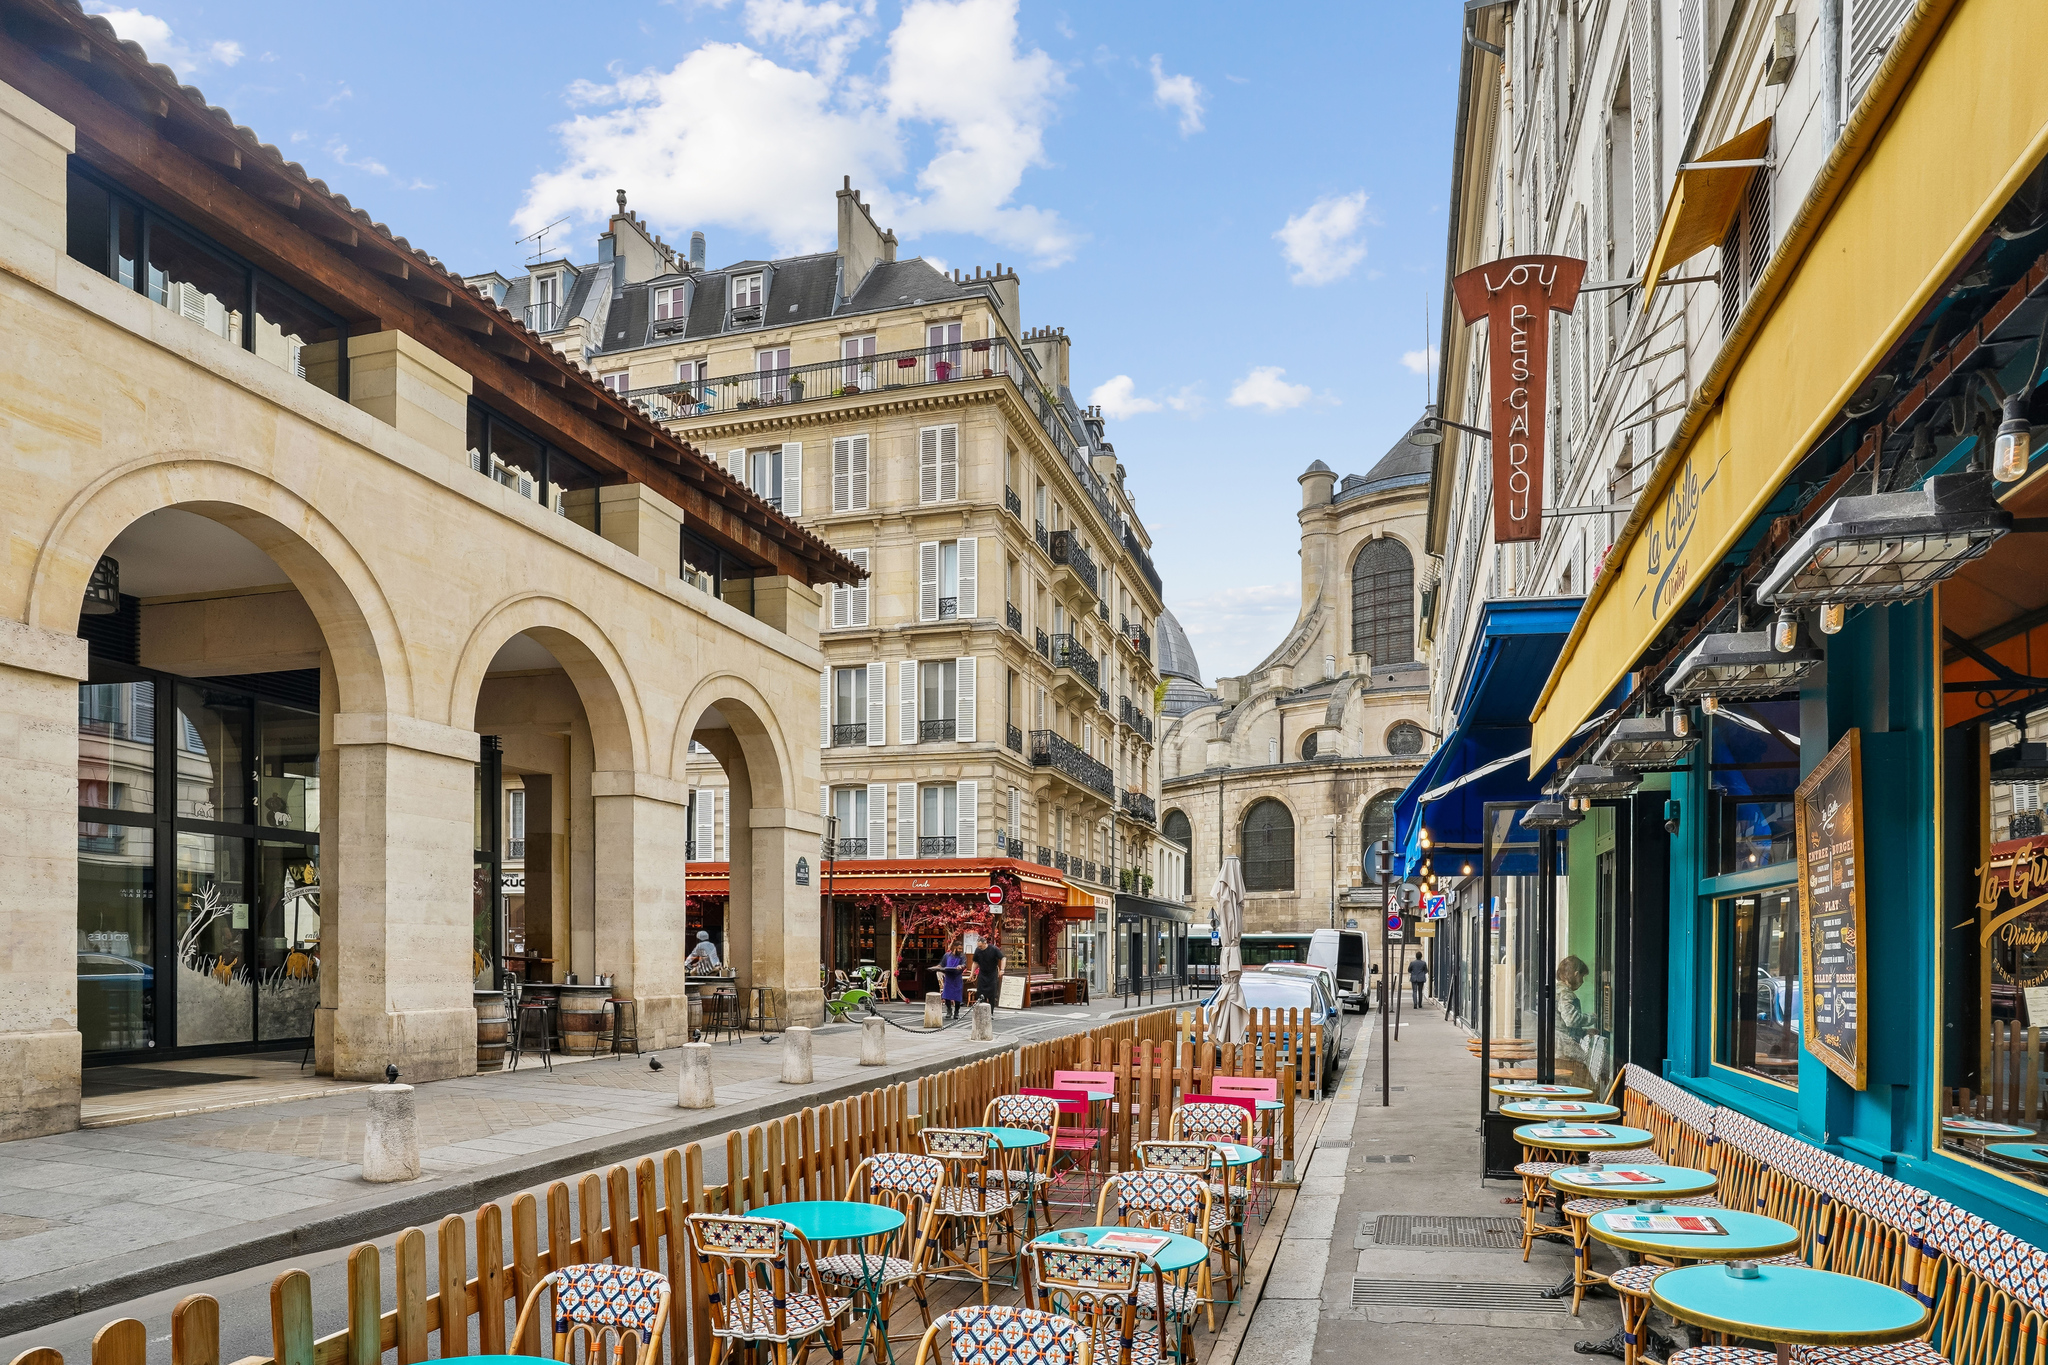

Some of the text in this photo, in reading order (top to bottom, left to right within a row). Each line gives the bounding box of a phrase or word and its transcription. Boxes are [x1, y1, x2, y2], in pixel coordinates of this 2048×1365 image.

[1508, 304, 1532, 522] PESCADOU
[1644, 456, 1700, 575] La Grille
[1663, 558, 1688, 607] Vintage
[1974, 861, 2001, 912] La
[2000, 922, 2048, 954] Vintage
[1992, 957, 2048, 989] FRENCH HOMEMAD
